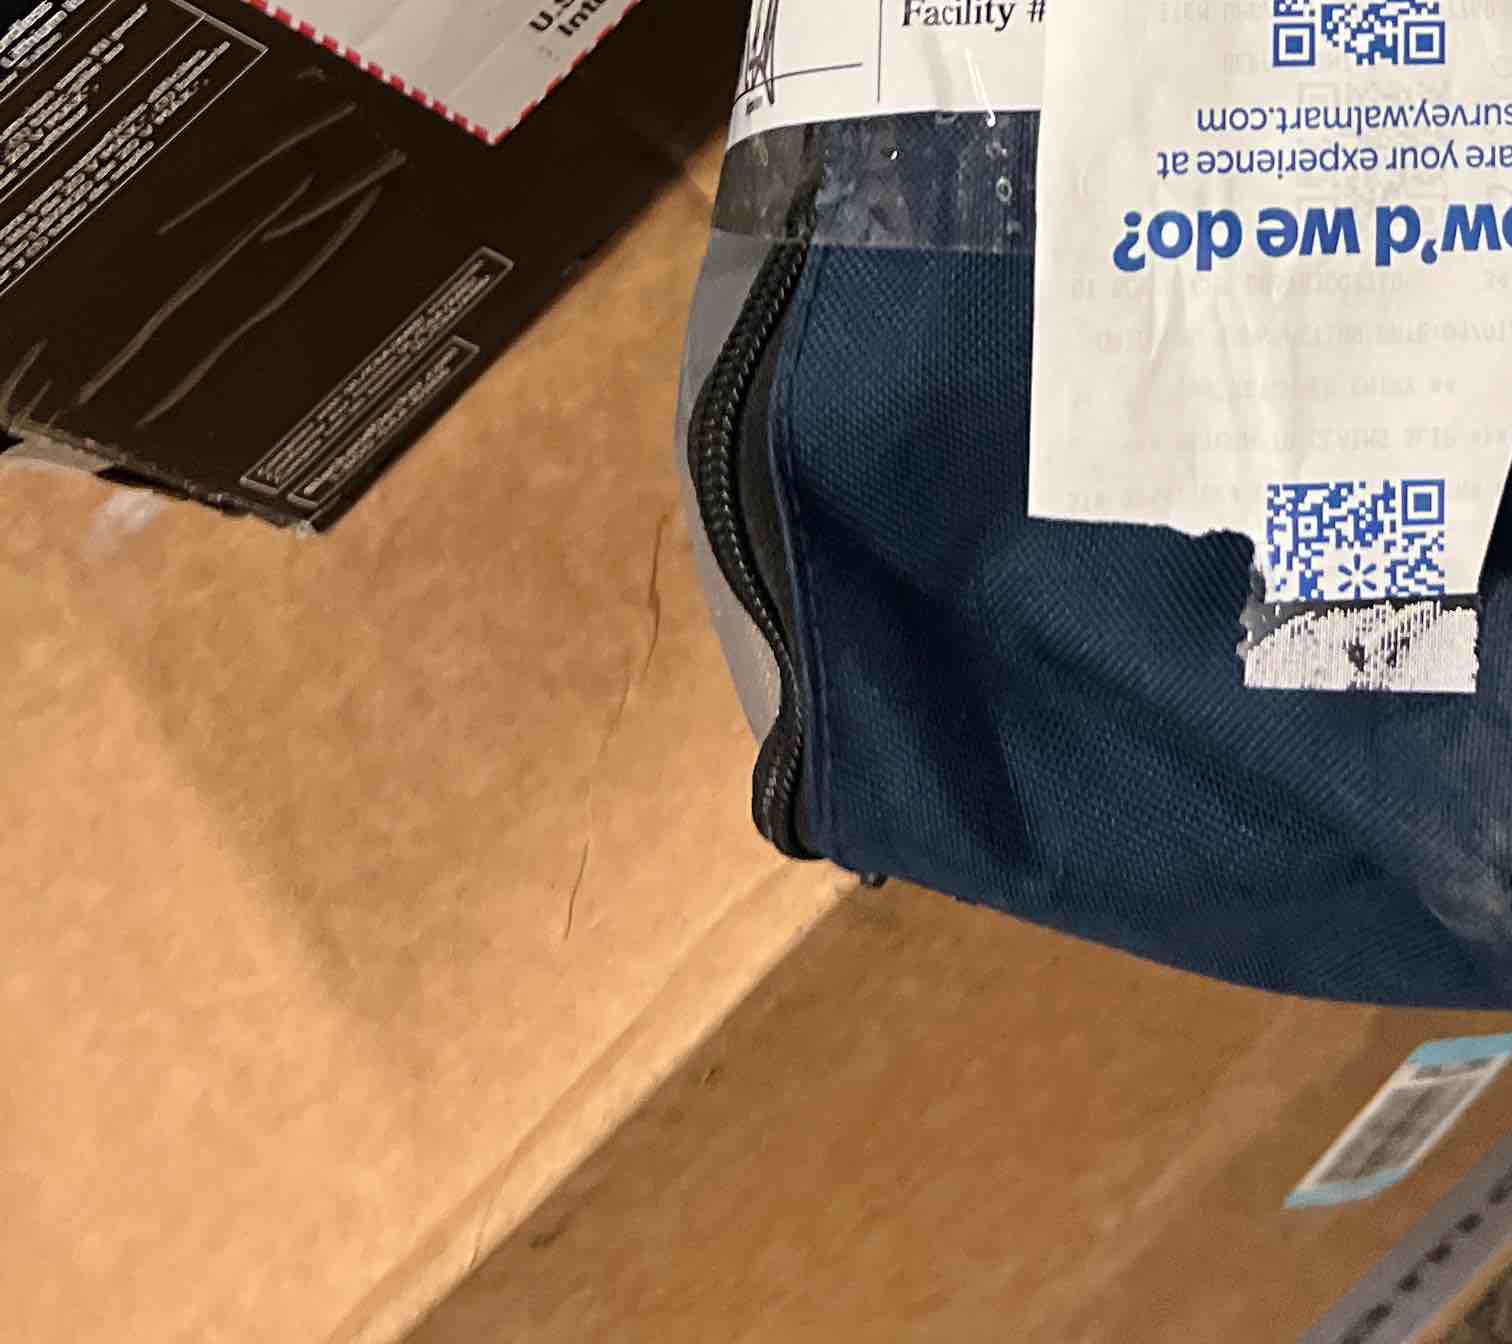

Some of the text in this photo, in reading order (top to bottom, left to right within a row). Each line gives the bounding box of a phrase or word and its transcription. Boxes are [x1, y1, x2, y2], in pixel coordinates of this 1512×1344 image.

[1156, 149, 1190, 180] at
[1197, 146, 1379, 179] experience
[1385, 141, 1458, 170] your
[1112, 208, 1243, 272] do?
[1256, 207, 1360, 258] we
